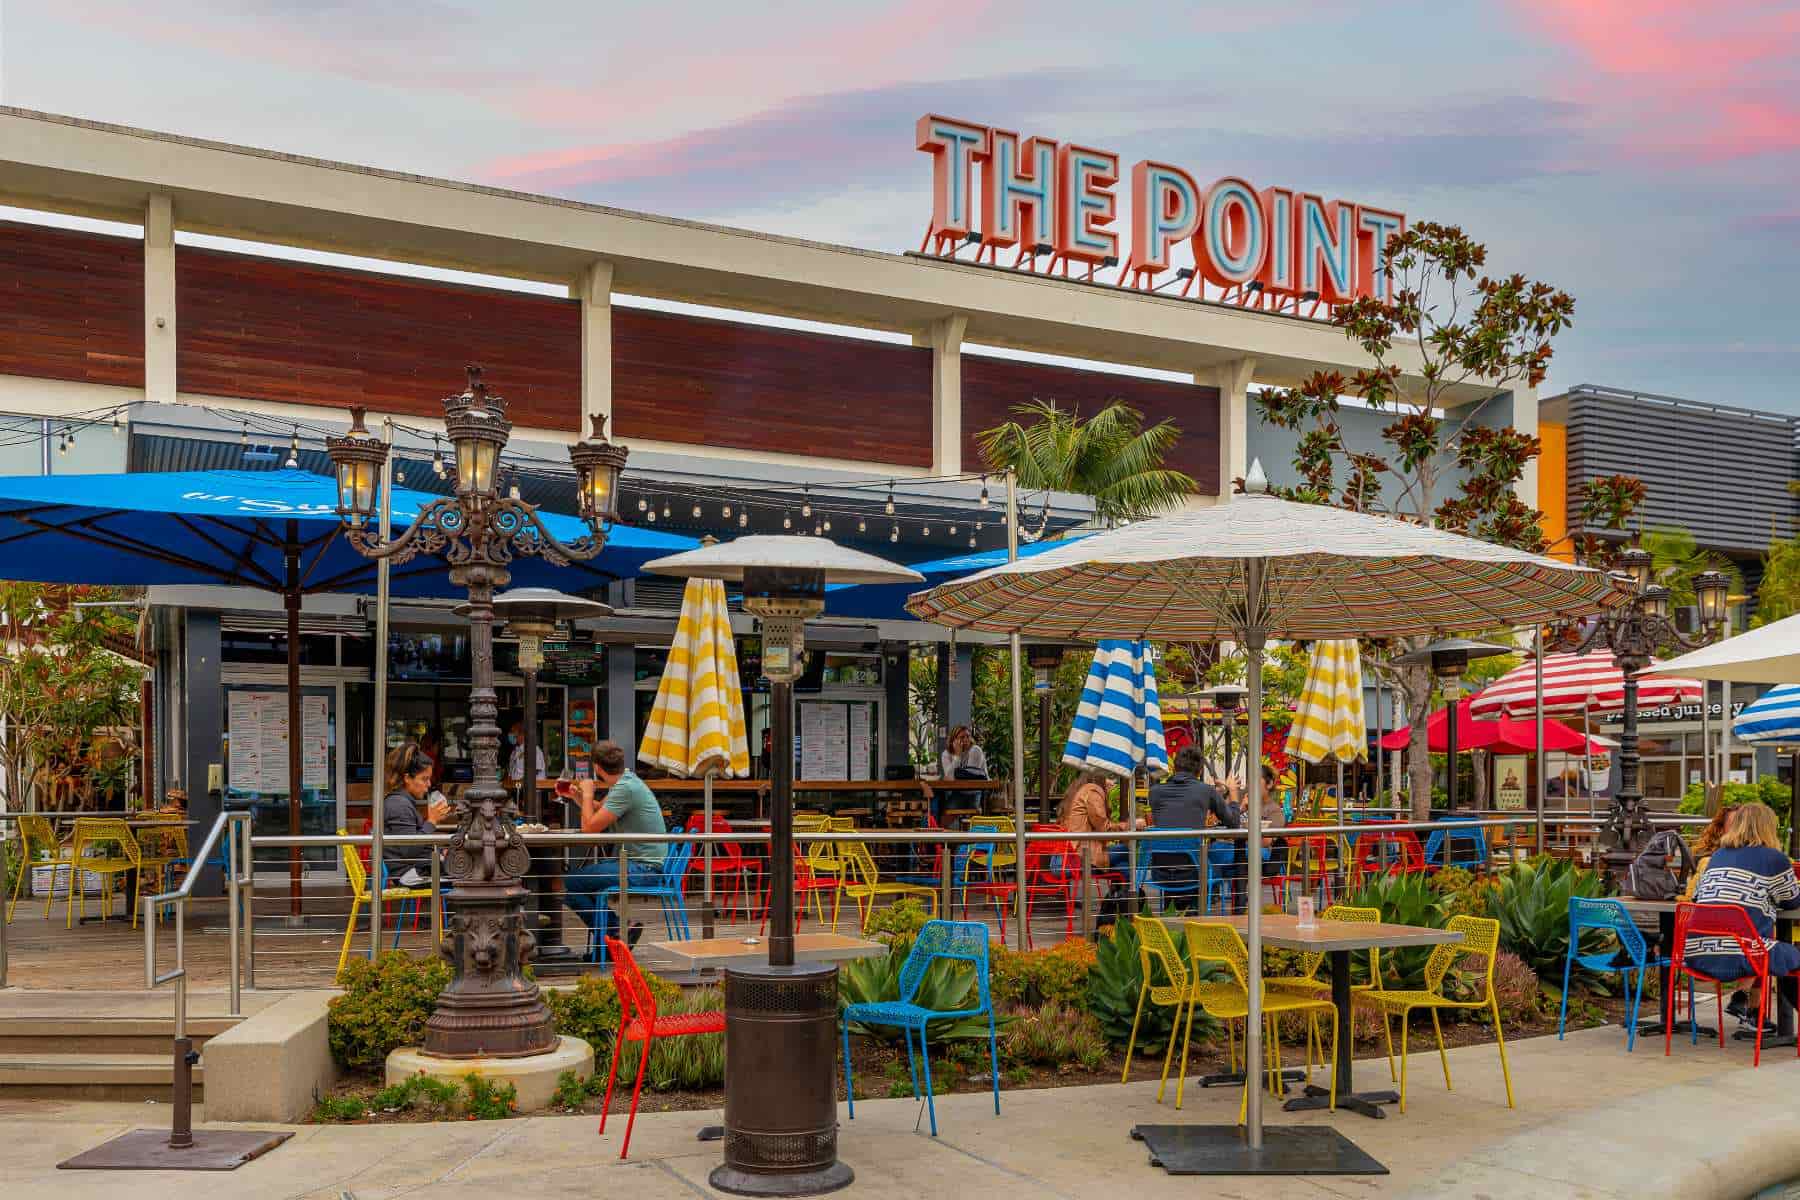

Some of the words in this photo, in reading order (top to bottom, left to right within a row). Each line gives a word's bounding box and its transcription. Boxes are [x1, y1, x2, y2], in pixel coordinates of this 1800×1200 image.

[916, 113, 1120, 266] THE
[1132, 159, 1406, 306] POINT
[1674, 702, 1744, 720] juiey
